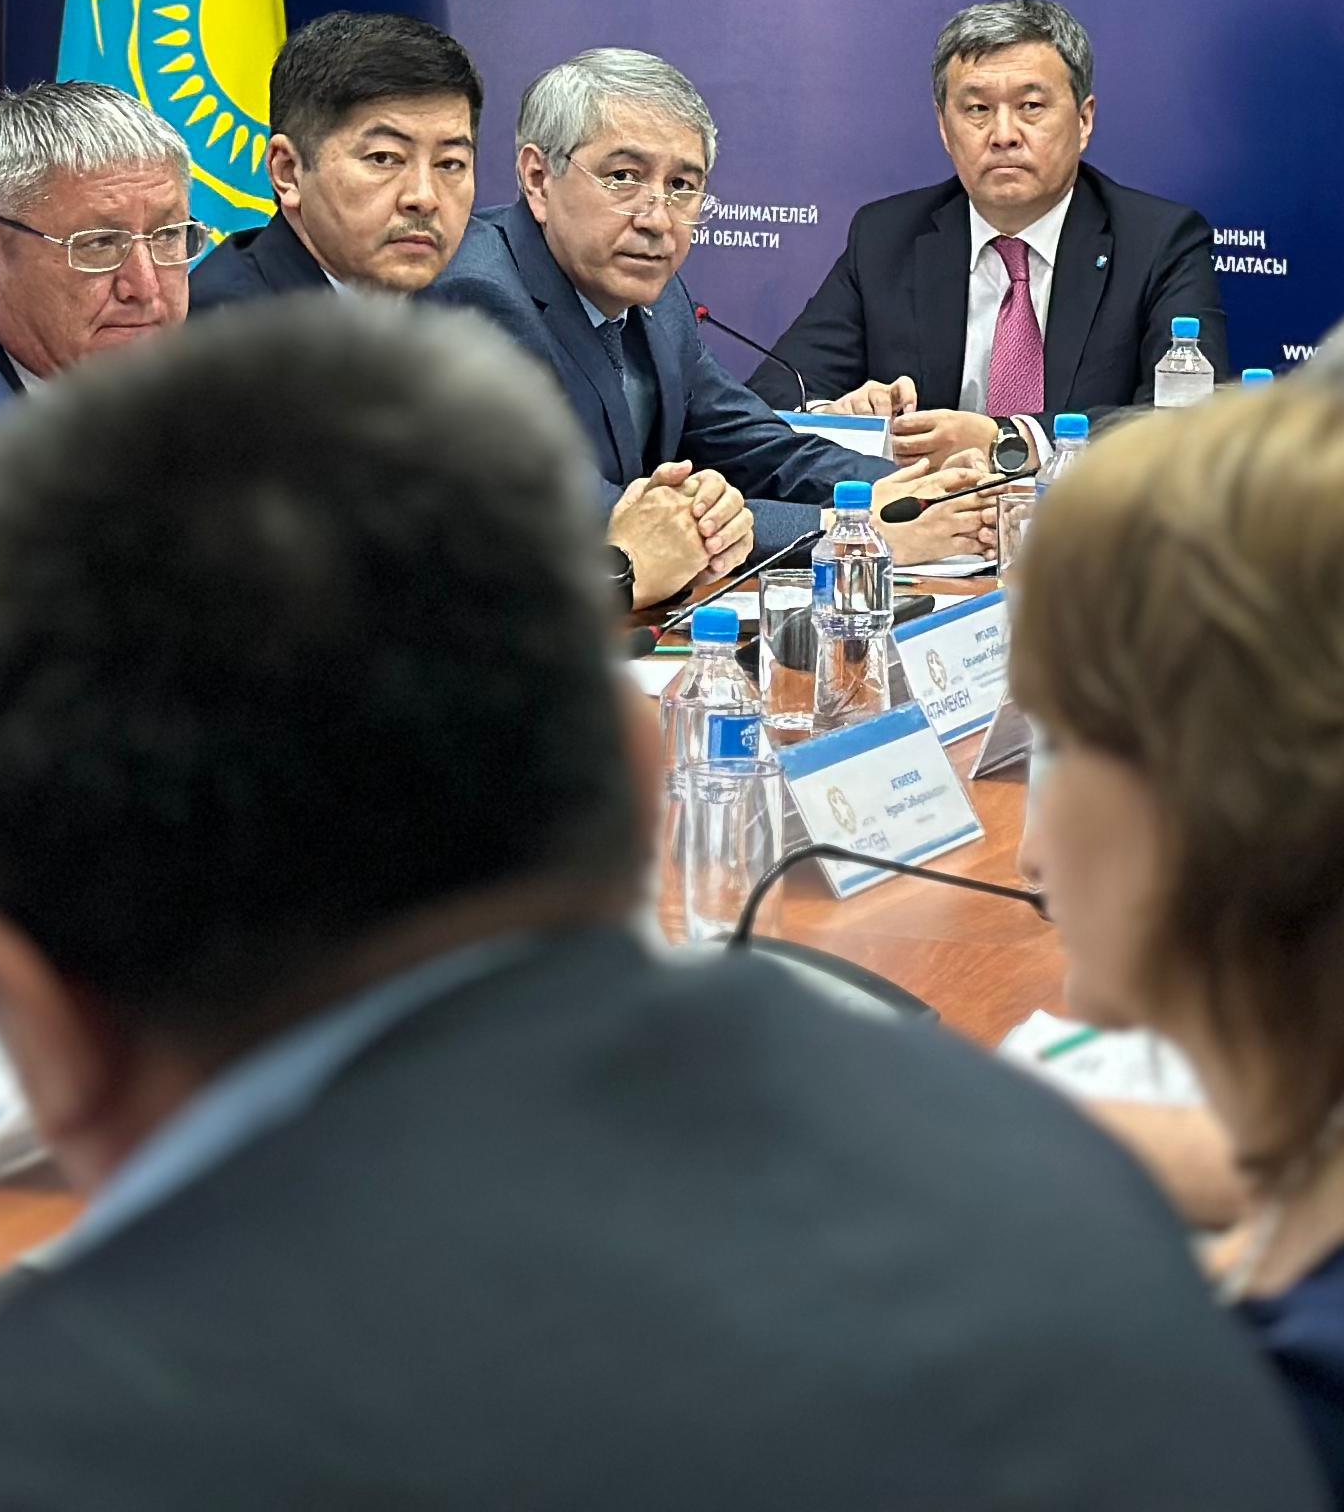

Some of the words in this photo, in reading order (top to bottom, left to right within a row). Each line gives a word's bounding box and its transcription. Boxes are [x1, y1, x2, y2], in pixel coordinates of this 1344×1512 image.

[691, 226, 710, 246] ОЙ
[713, 229, 780, 249] ОБЛАСТИ
[1213, 228, 1266, 250] ЫНЫҢ
[1211, 254, 1288, 276] АЛАТАСЫ
[1282, 344, 1319, 361] ww
